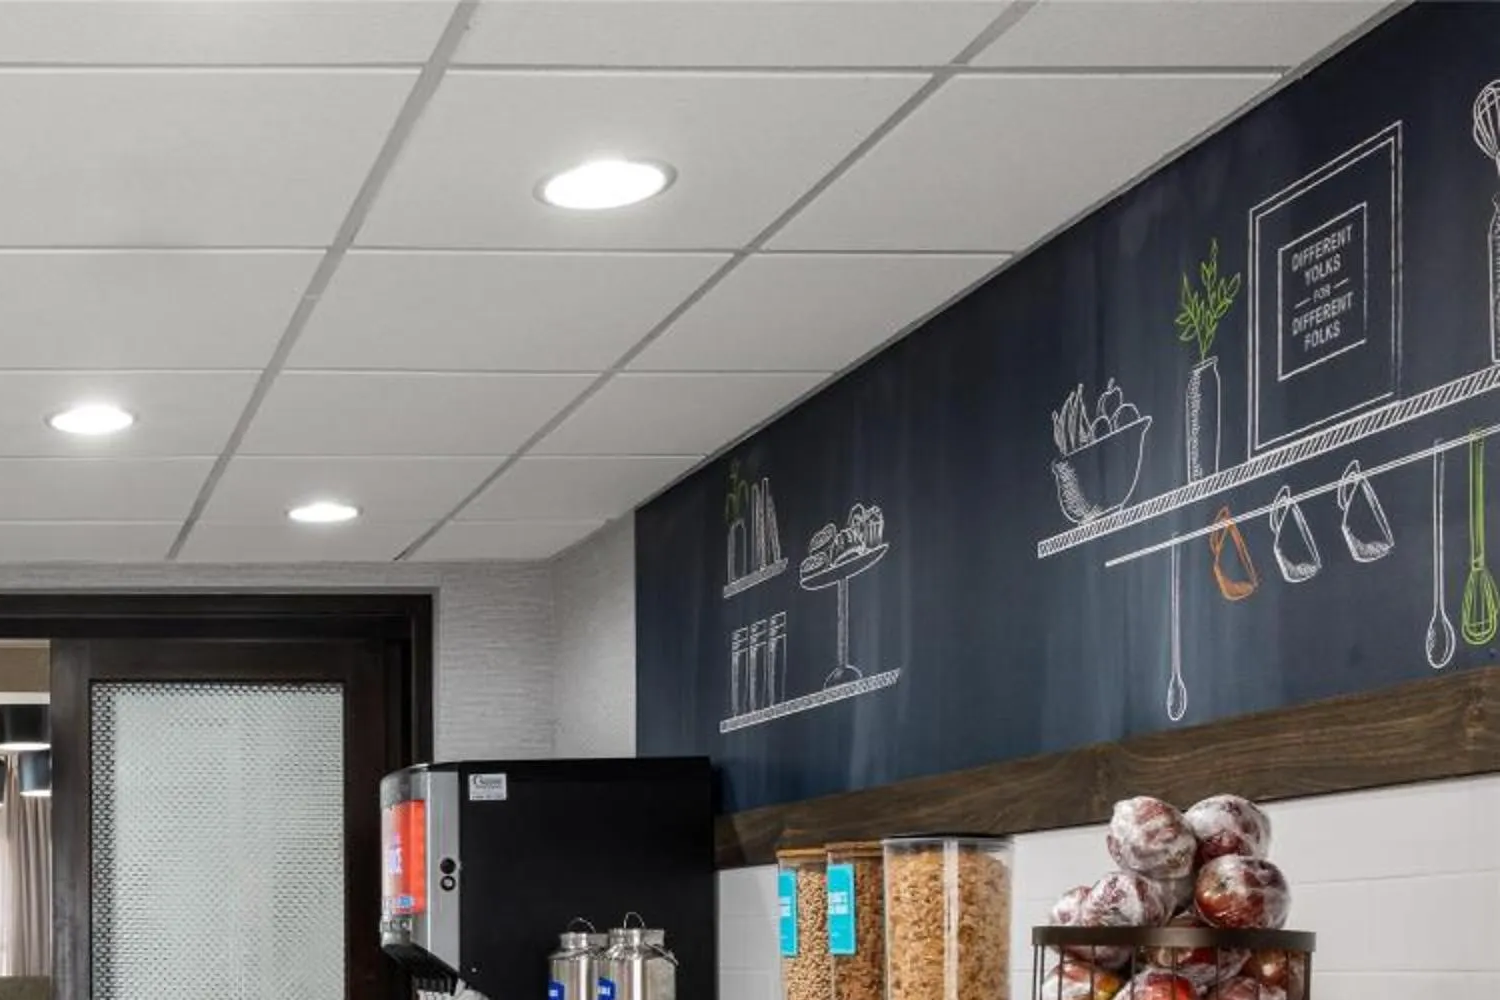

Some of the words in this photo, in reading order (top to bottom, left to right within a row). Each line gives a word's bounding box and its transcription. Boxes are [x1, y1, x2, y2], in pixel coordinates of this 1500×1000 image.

[1291, 223, 1353, 272] DIFFERENT
[1303, 253, 1342, 286] YOLKS
[1292, 291, 1354, 337] DIFFERENT
[1303, 319, 1341, 352] FOLKS
